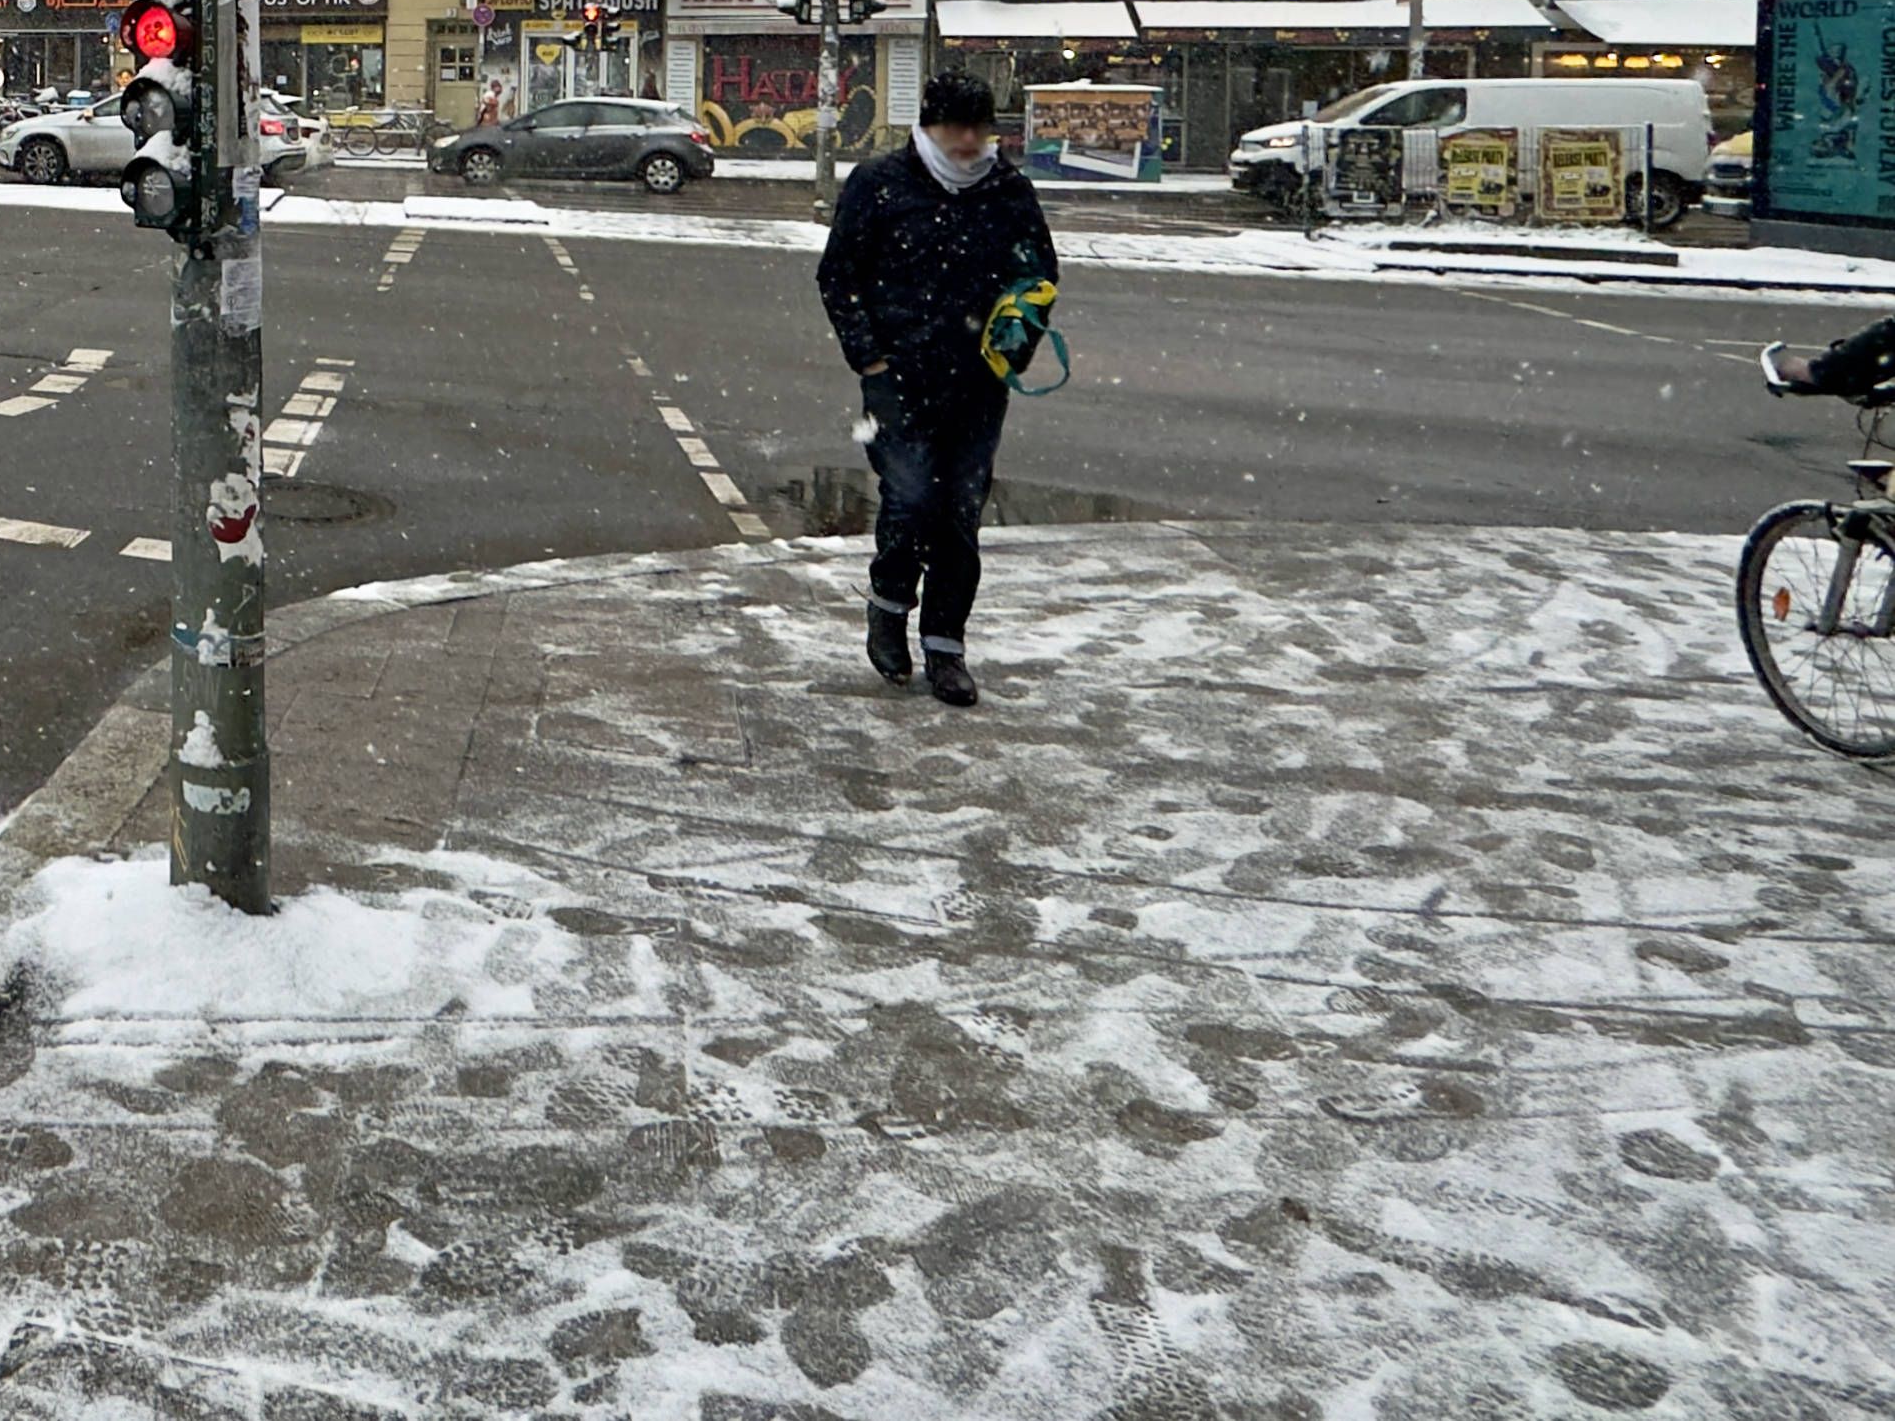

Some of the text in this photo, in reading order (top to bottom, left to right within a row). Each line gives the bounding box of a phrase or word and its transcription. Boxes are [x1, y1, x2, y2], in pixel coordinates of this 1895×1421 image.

[1778, 0, 1858, 19] WORLD
[1776, 22, 1797, 132] WHERE THE
